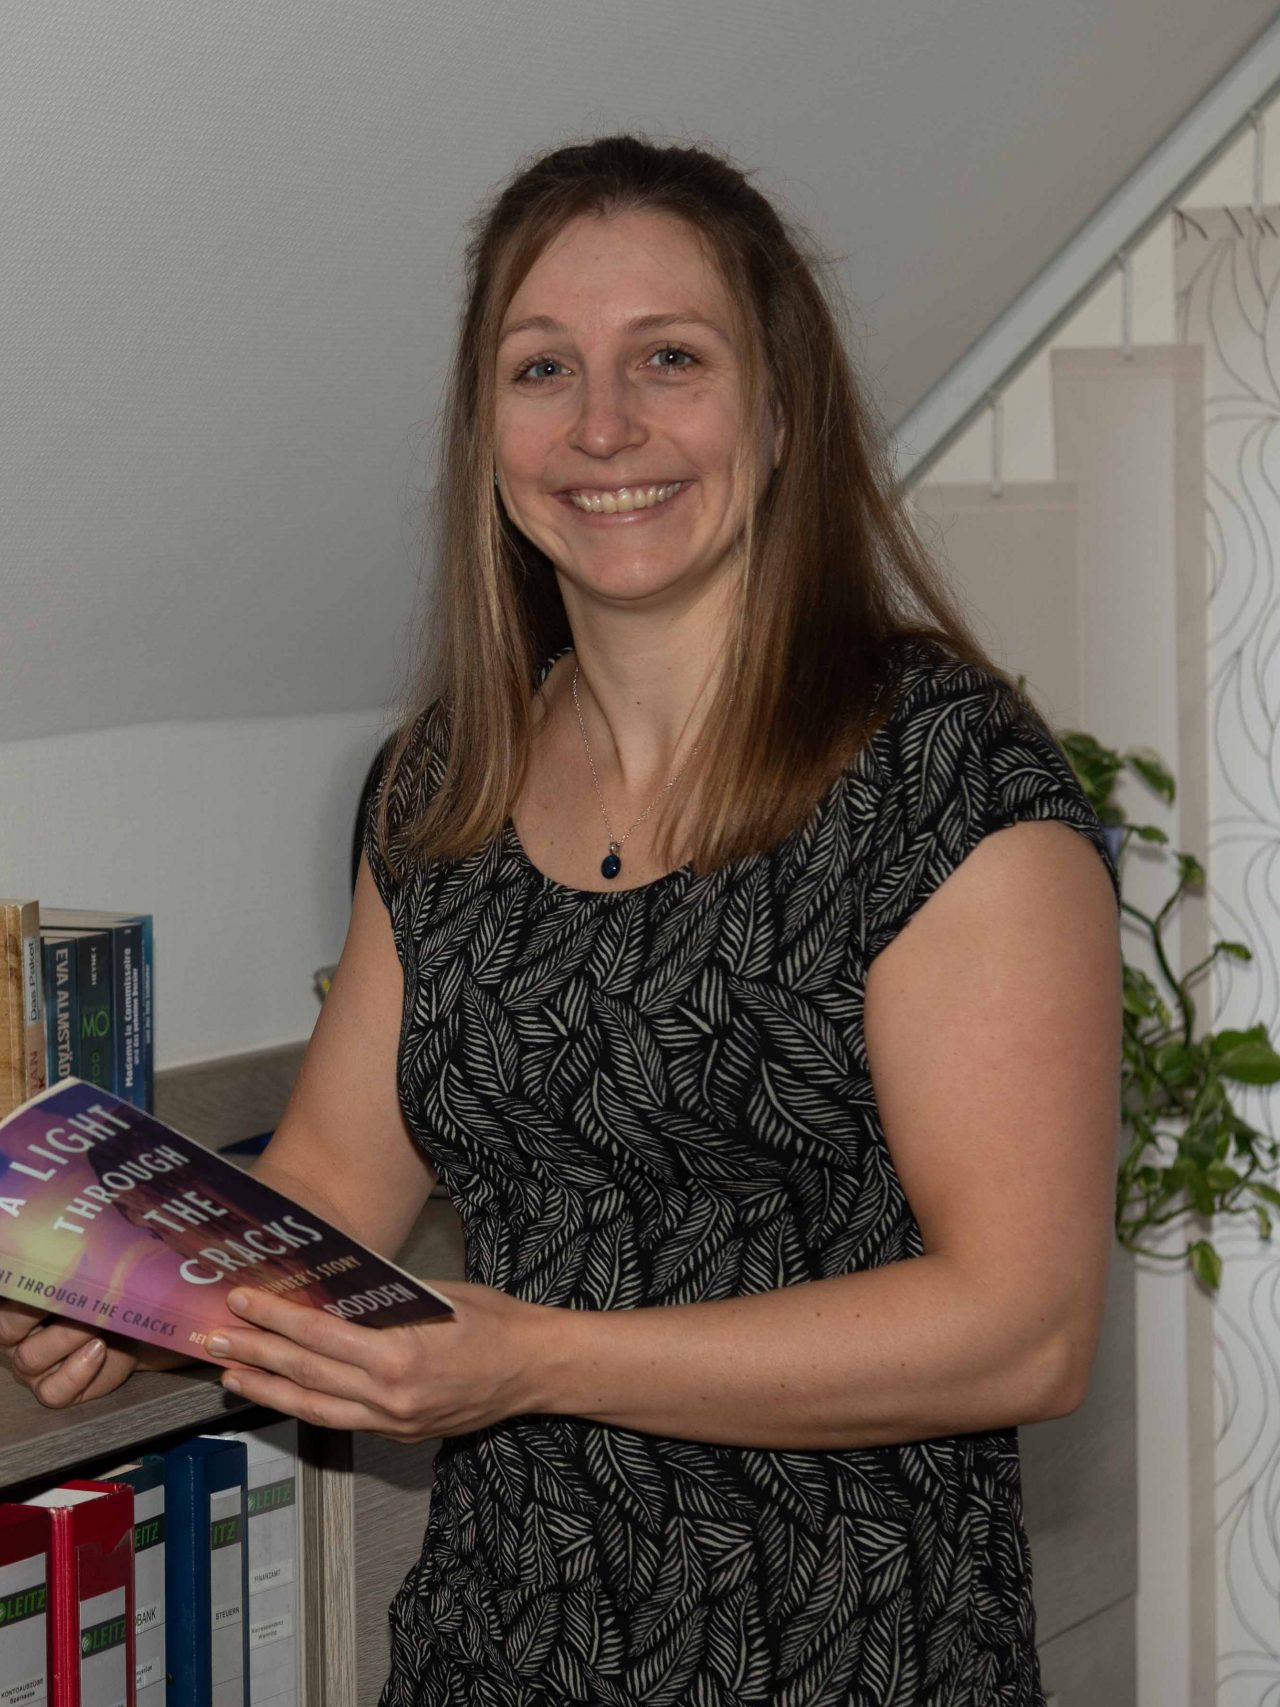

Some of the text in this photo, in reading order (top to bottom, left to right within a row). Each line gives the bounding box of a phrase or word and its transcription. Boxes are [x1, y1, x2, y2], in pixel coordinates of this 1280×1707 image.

[27, 942, 38, 1021] Das Paket
[55, 947, 69, 986] EVA
[123, 947, 134, 1088] Madame le Commissaire
[10, 1104, 131, 1183] LIGHT
[53, 1145, 190, 1235] THROUGH
[143, 1190, 229, 1233] THE
[179, 1214, 324, 1285] CRACKS
[322, 1254, 362, 1281] STORY
[17, 1275, 89, 1310] THROUGH
[90, 1299, 120, 1320] THE
[123, 1310, 177, 1337] CRACKS
[323, 1282, 419, 1321] RODDEN
[256, 1486, 291, 1511] LEITZ
[6, 1588, 46, 1619] LEITZ
[215, 1606, 240, 1621] STEUERN
[92, 1621, 126, 1652] LEITZ
